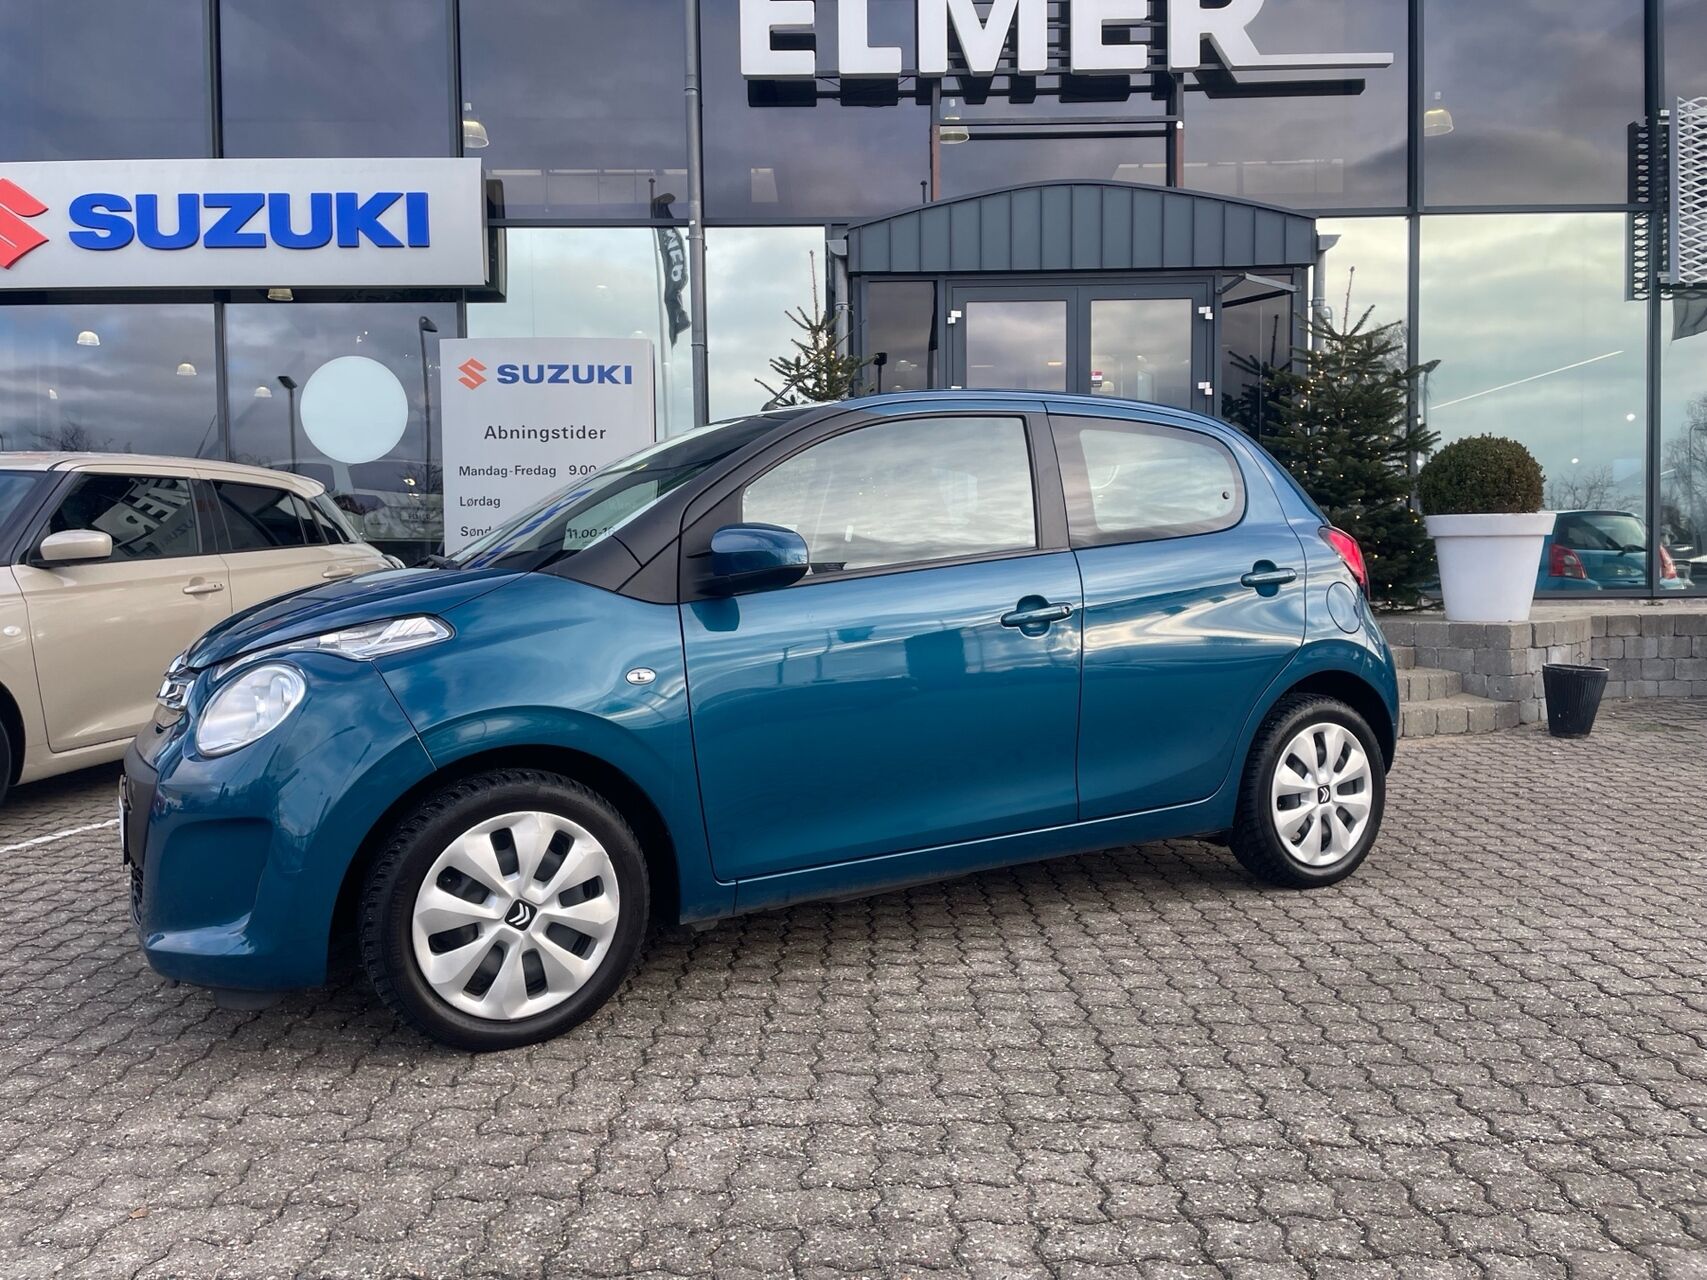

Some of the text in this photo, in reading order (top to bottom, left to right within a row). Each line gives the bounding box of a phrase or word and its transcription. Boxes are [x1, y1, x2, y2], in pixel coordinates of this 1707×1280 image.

[741, 0, 1394, 80] ELMER
[68, 191, 430, 251] SUZUKI
[497, 364, 632, 385] SUZUKI
[484, 425, 607, 443] Abningstider
[459, 464, 557, 478] Mandag-Fredag
[460, 496, 501, 508] Lørdag
